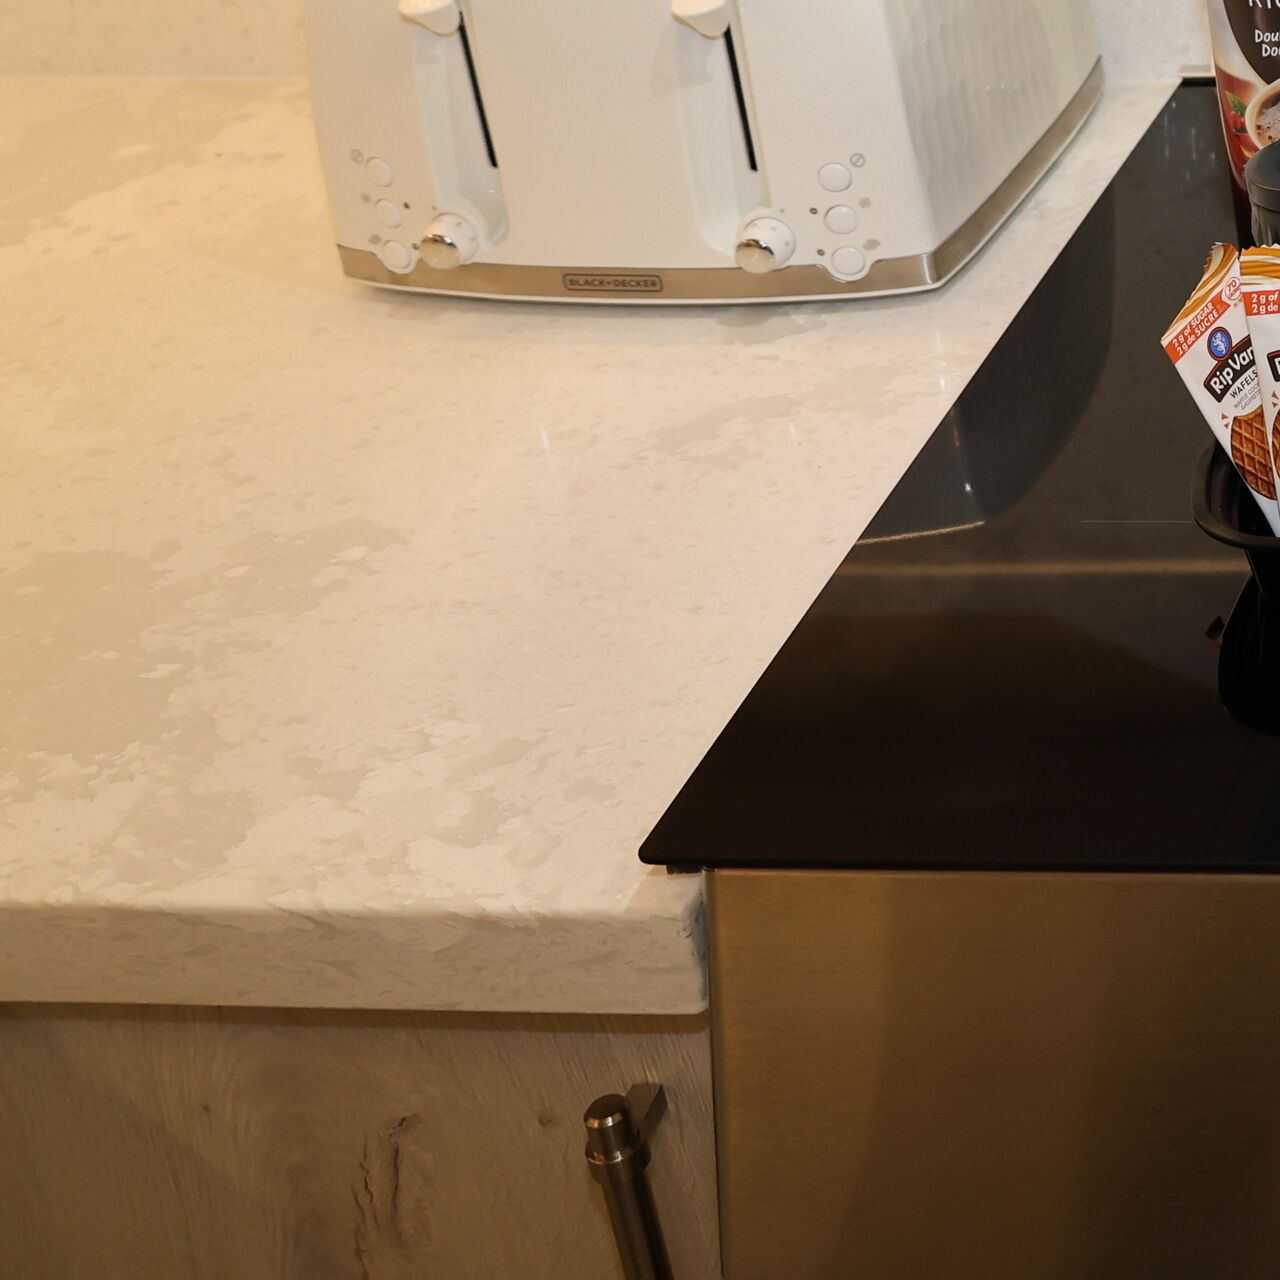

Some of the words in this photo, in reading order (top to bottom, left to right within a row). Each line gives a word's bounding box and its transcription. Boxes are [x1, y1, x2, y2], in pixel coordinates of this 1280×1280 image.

[569, 279, 657, 288] BLACK+DECKER
[1251, 294, 1258, 303] 2
[1259, 294, 1267, 305] g
[1269, 292, 1280, 302] of
[1251, 304, 1259, 313] 2
[1267, 303, 1279, 312] de
[1191, 302, 1215, 327] SUGAR
[1195, 311, 1220, 337] SUCRE
[1230, 369, 1259, 399] WAFELS
